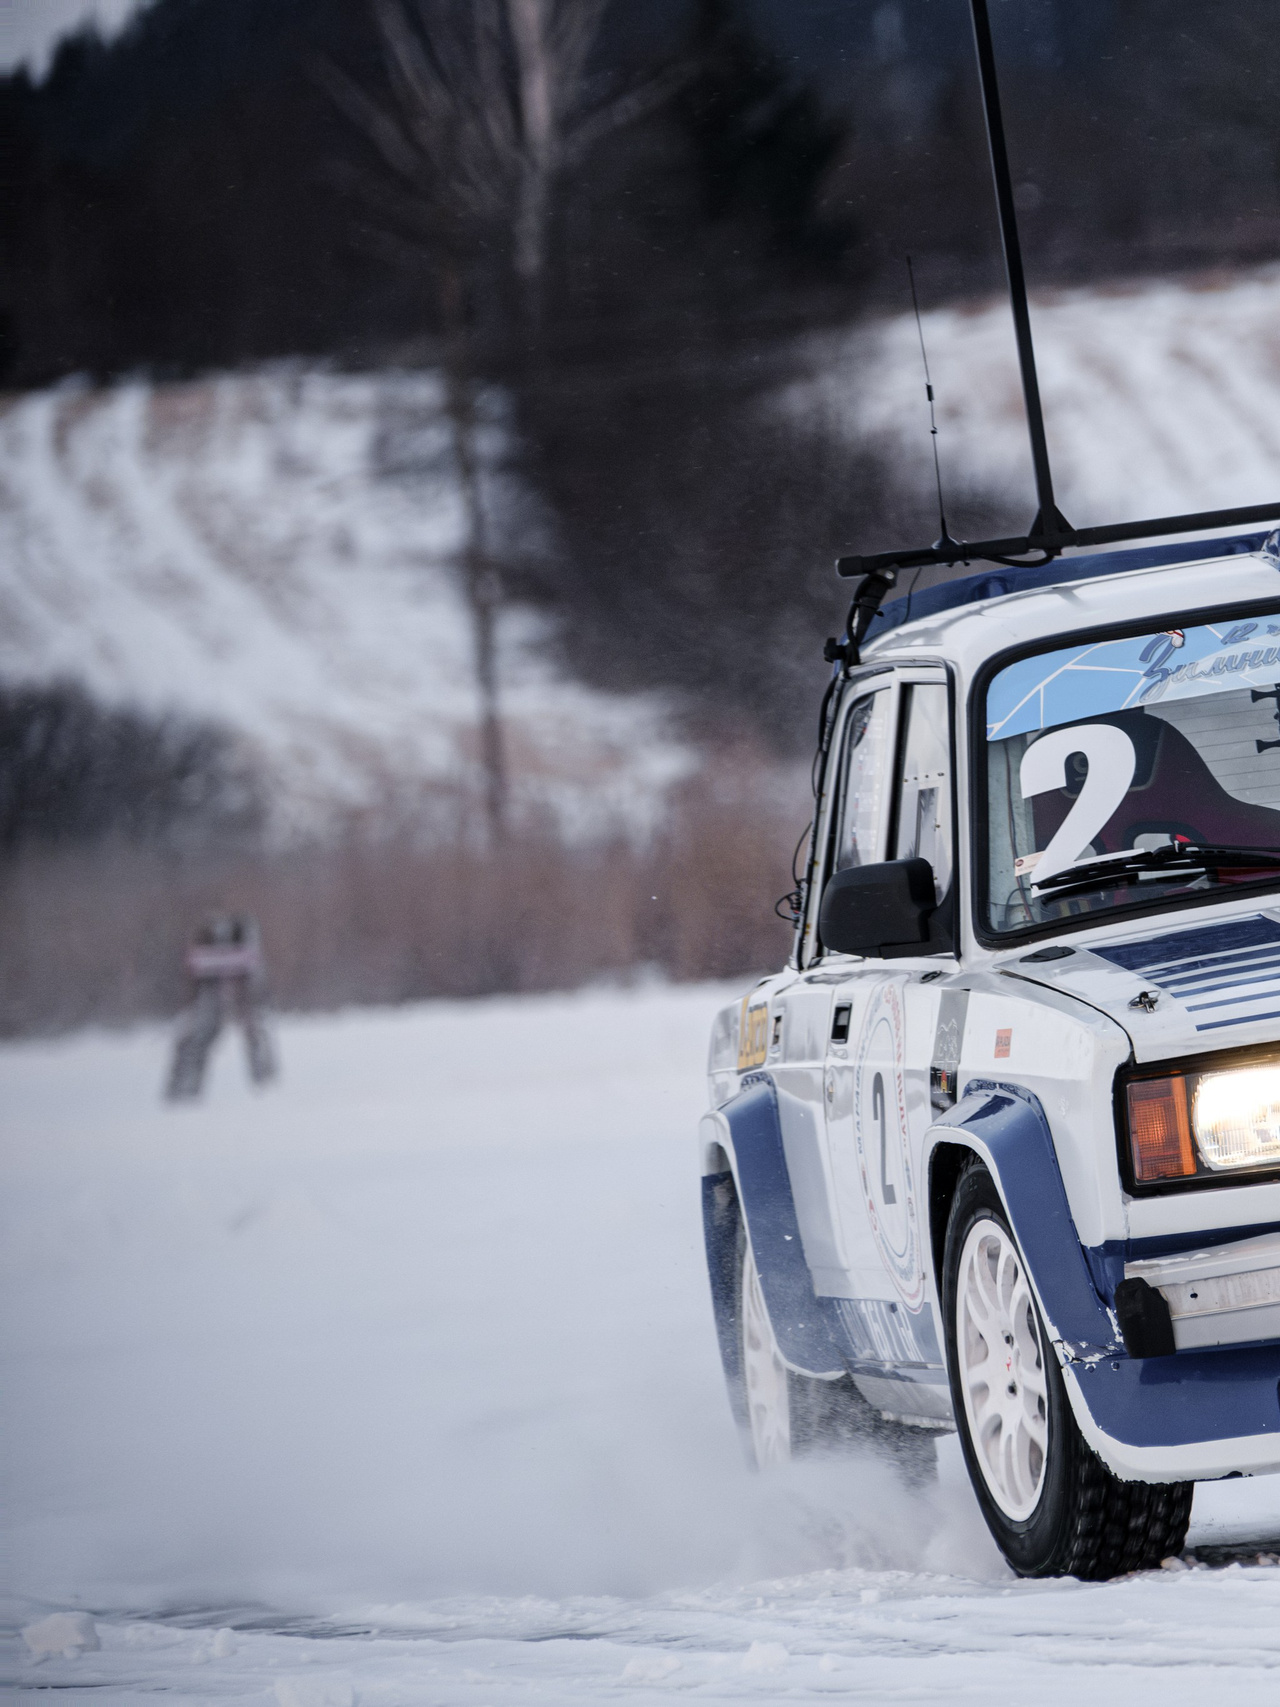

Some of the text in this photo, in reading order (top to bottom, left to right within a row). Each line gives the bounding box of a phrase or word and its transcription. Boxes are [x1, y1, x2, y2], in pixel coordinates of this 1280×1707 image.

[1221, 622, 1258, 646] 12
[1020, 723, 1145, 898] 2
[873, 1071, 897, 1205] 2
